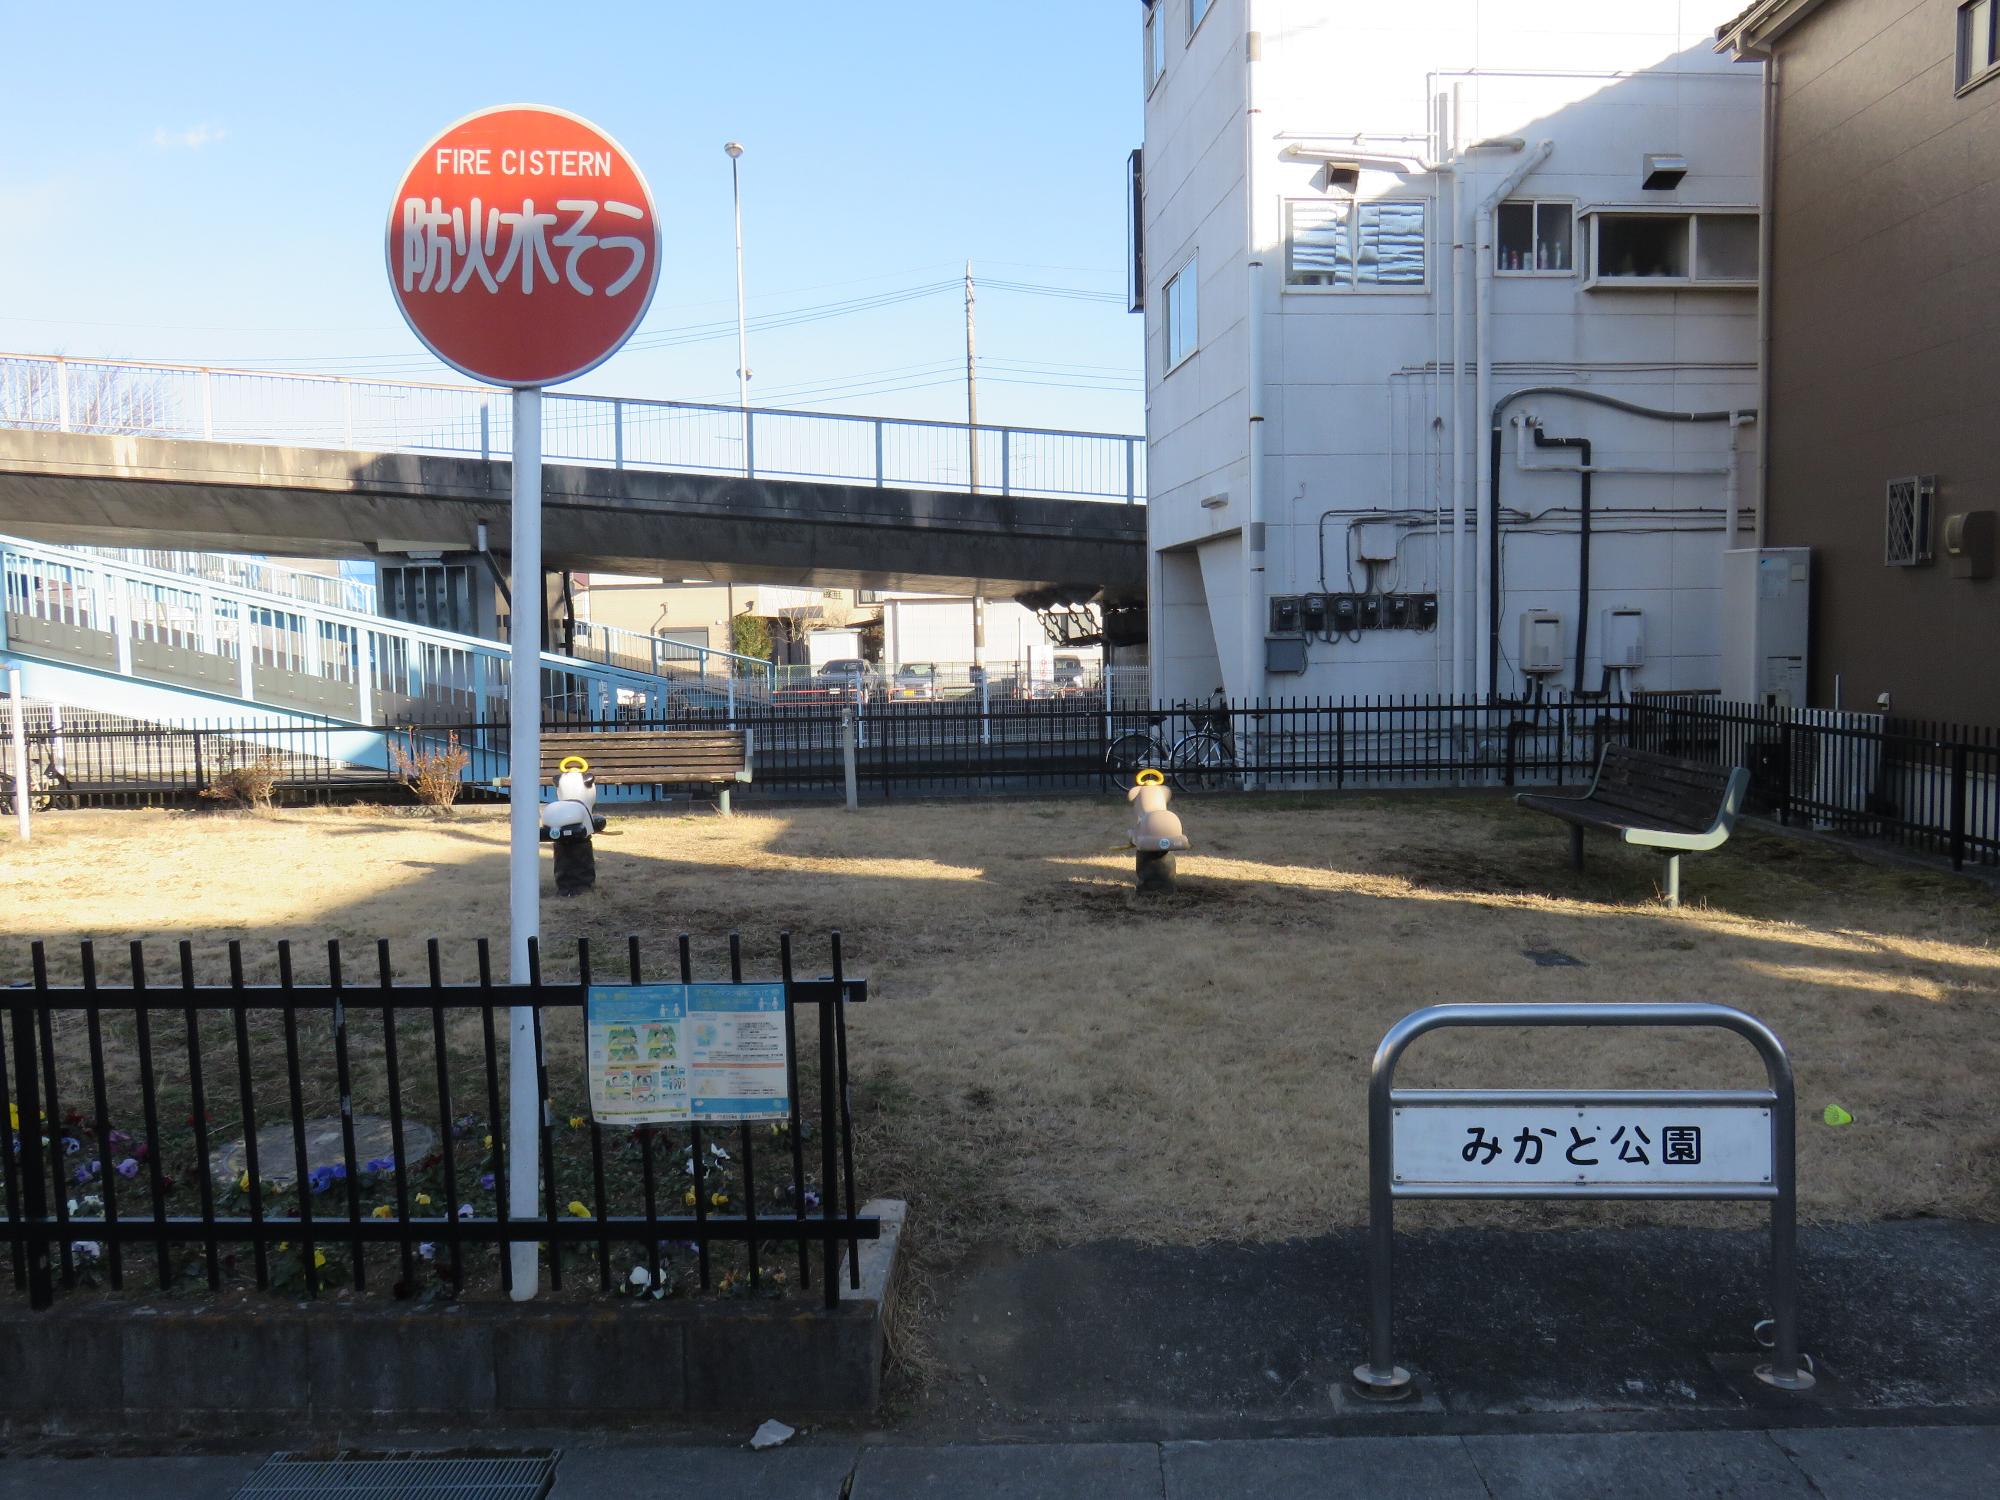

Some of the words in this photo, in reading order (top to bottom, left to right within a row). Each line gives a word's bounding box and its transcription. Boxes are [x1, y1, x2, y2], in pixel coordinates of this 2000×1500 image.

[436, 148, 491, 175] FIRE
[501, 149, 612, 177] CISTERN
[403, 197, 646, 297] 防火水そう
[1461, 1126, 1702, 1165] みかど公園
